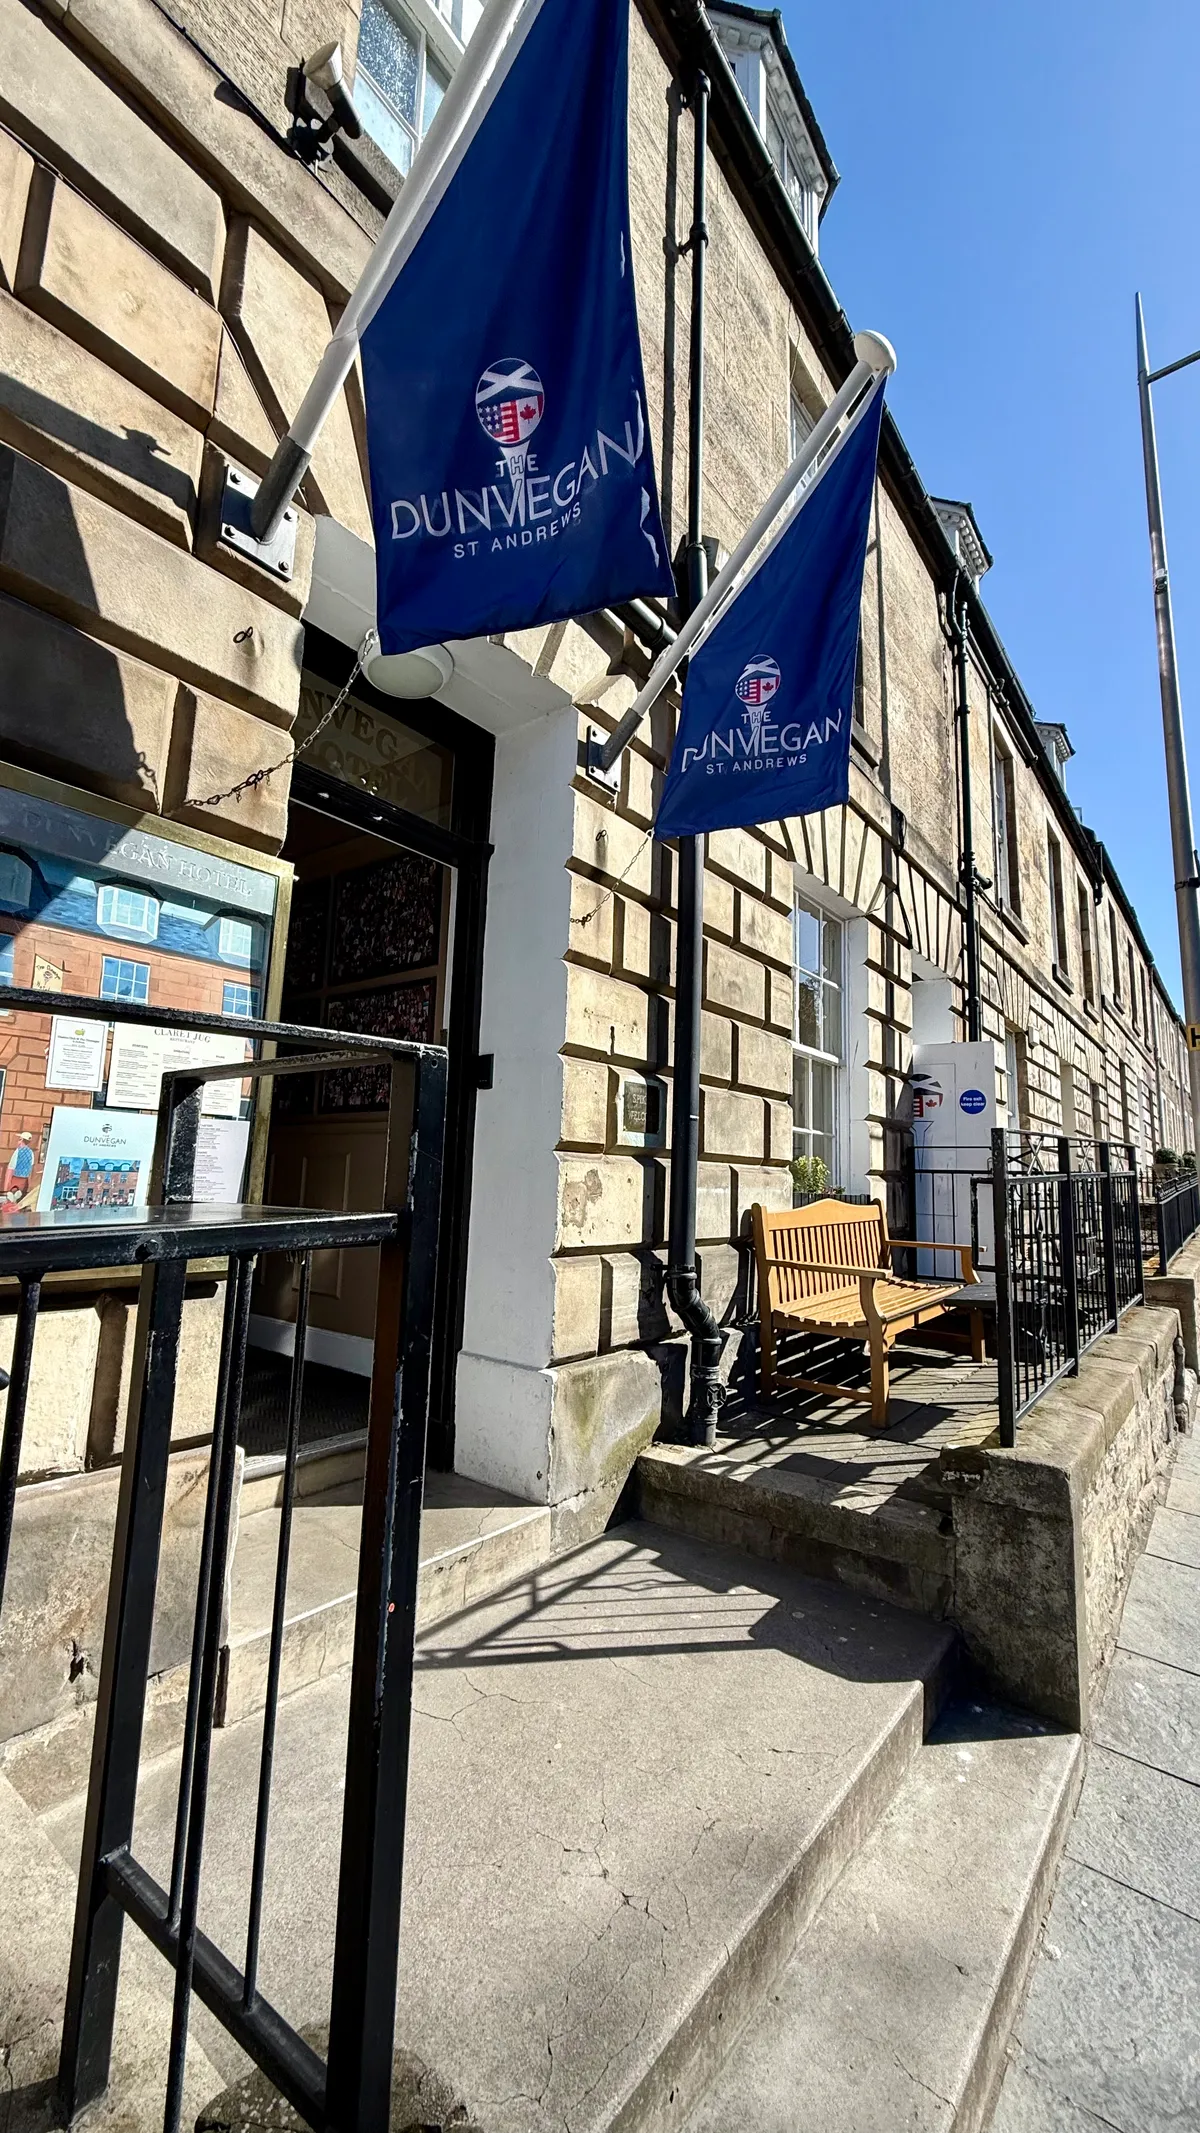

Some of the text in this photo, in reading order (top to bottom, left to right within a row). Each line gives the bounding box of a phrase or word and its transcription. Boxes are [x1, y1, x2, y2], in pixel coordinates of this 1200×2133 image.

[495, 453, 539, 478] THE
[390, 421, 637, 540] DUNVEGAN
[453, 501, 582, 559] ST ANDREWS
[741, 711, 772, 725] THE
[706, 753, 807, 776] ST ANDREWS
[179, 859, 253, 897] HOTEL
[193, 1033, 211, 1043] JUG
[83, 1135, 127, 1145] DUNVEGAN
